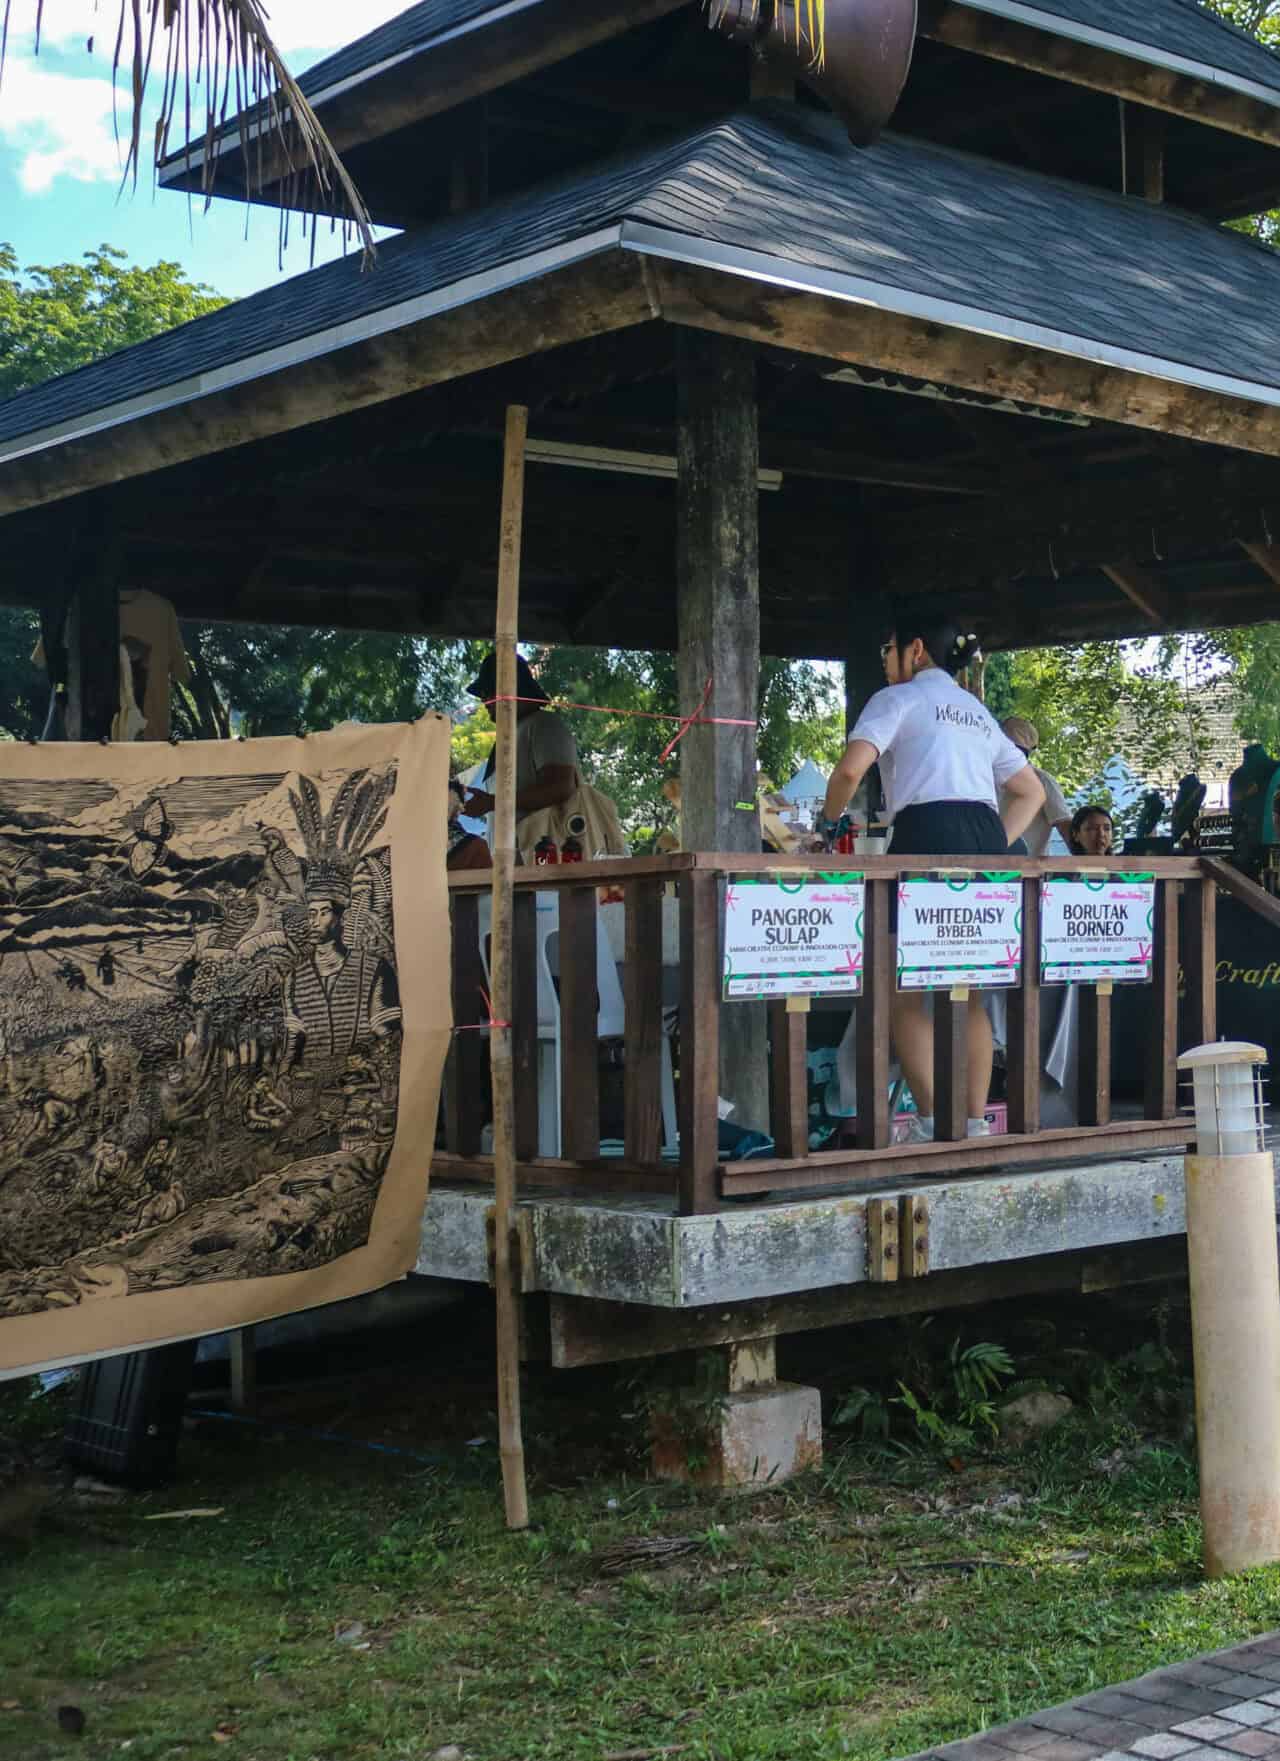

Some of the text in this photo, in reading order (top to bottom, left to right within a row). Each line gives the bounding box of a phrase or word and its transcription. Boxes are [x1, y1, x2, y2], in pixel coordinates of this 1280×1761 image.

[751, 908, 833, 926] PANGROK
[915, 907, 1004, 925] WHITEDAISY
[1063, 904, 1128, 920] BORUTAK
[765, 927, 819, 945] SULAP
[936, 925, 982, 938] BYBEBA
[1067, 921, 1124, 937] BORNEO
